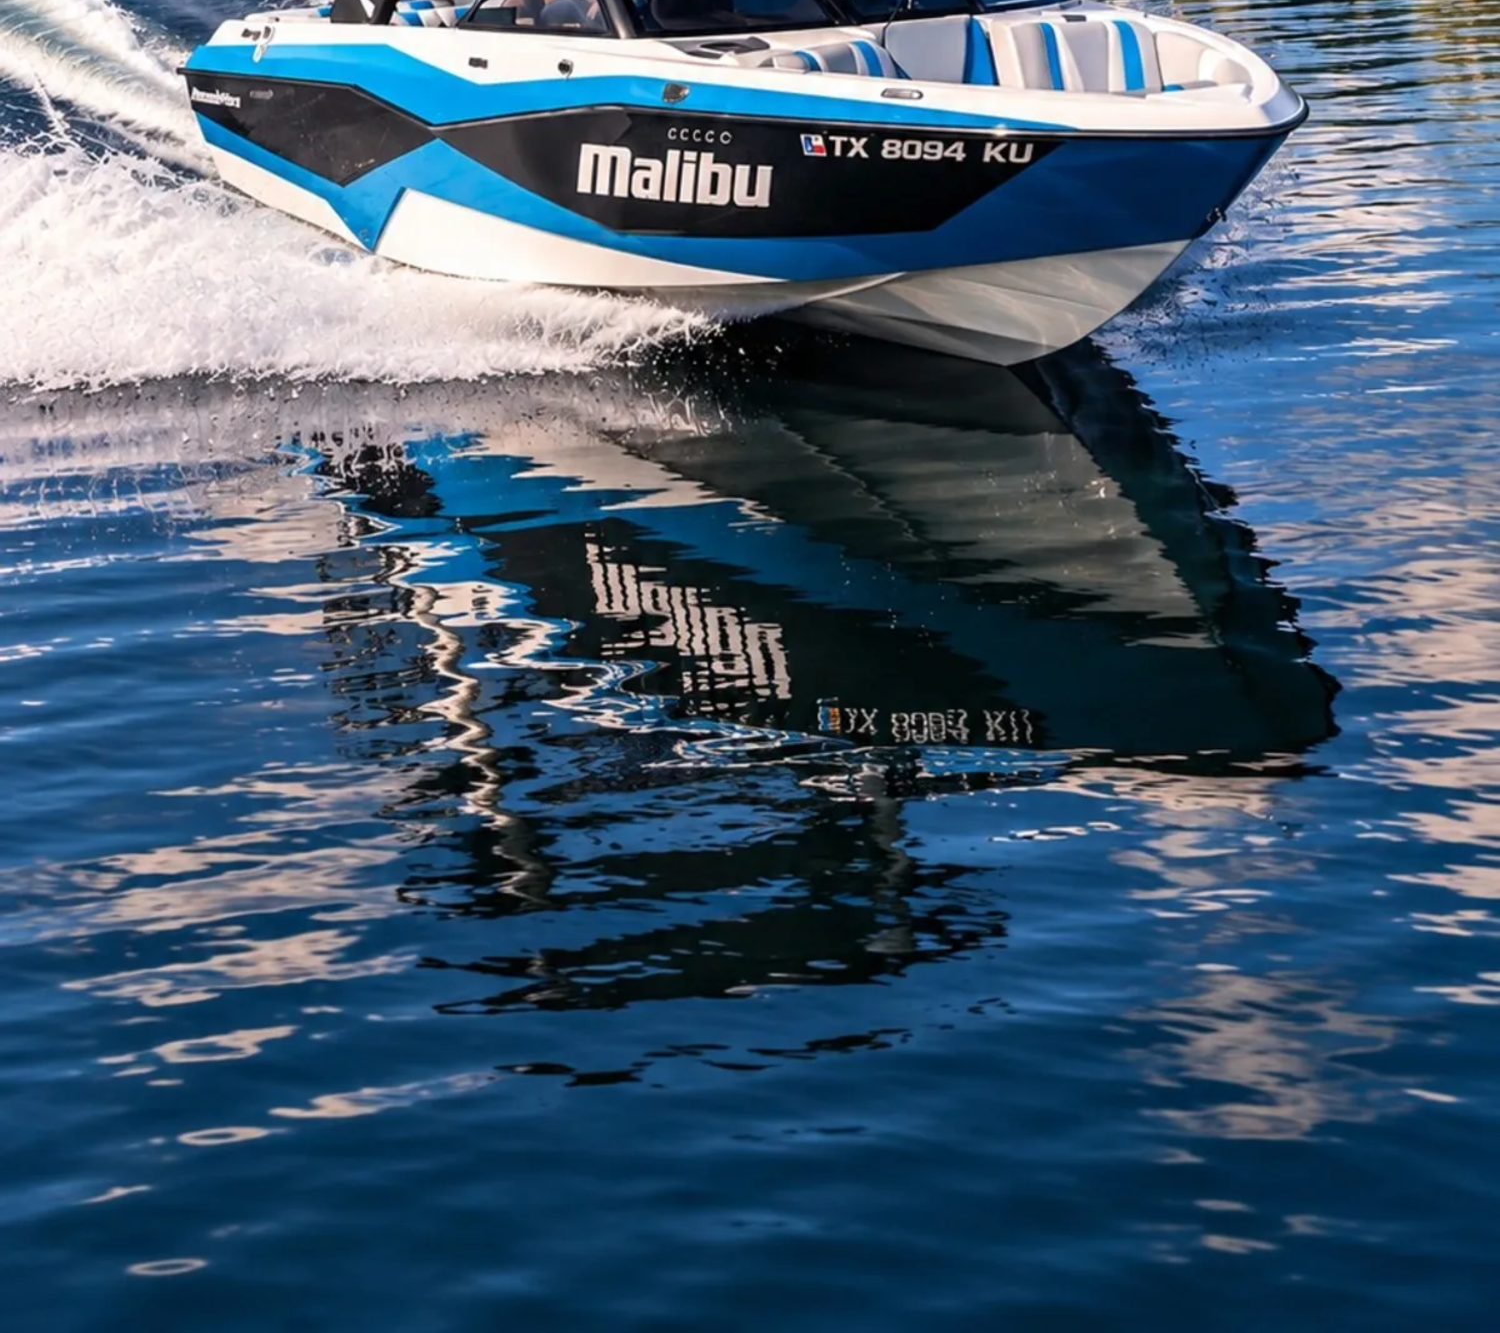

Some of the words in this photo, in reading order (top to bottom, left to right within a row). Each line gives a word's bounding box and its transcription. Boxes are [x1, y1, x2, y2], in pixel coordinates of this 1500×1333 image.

[829, 135, 869, 158] TX
[881, 139, 966, 162] 8094
[983, 142, 1033, 163] KU
[576, 144, 773, 208] Malibu
